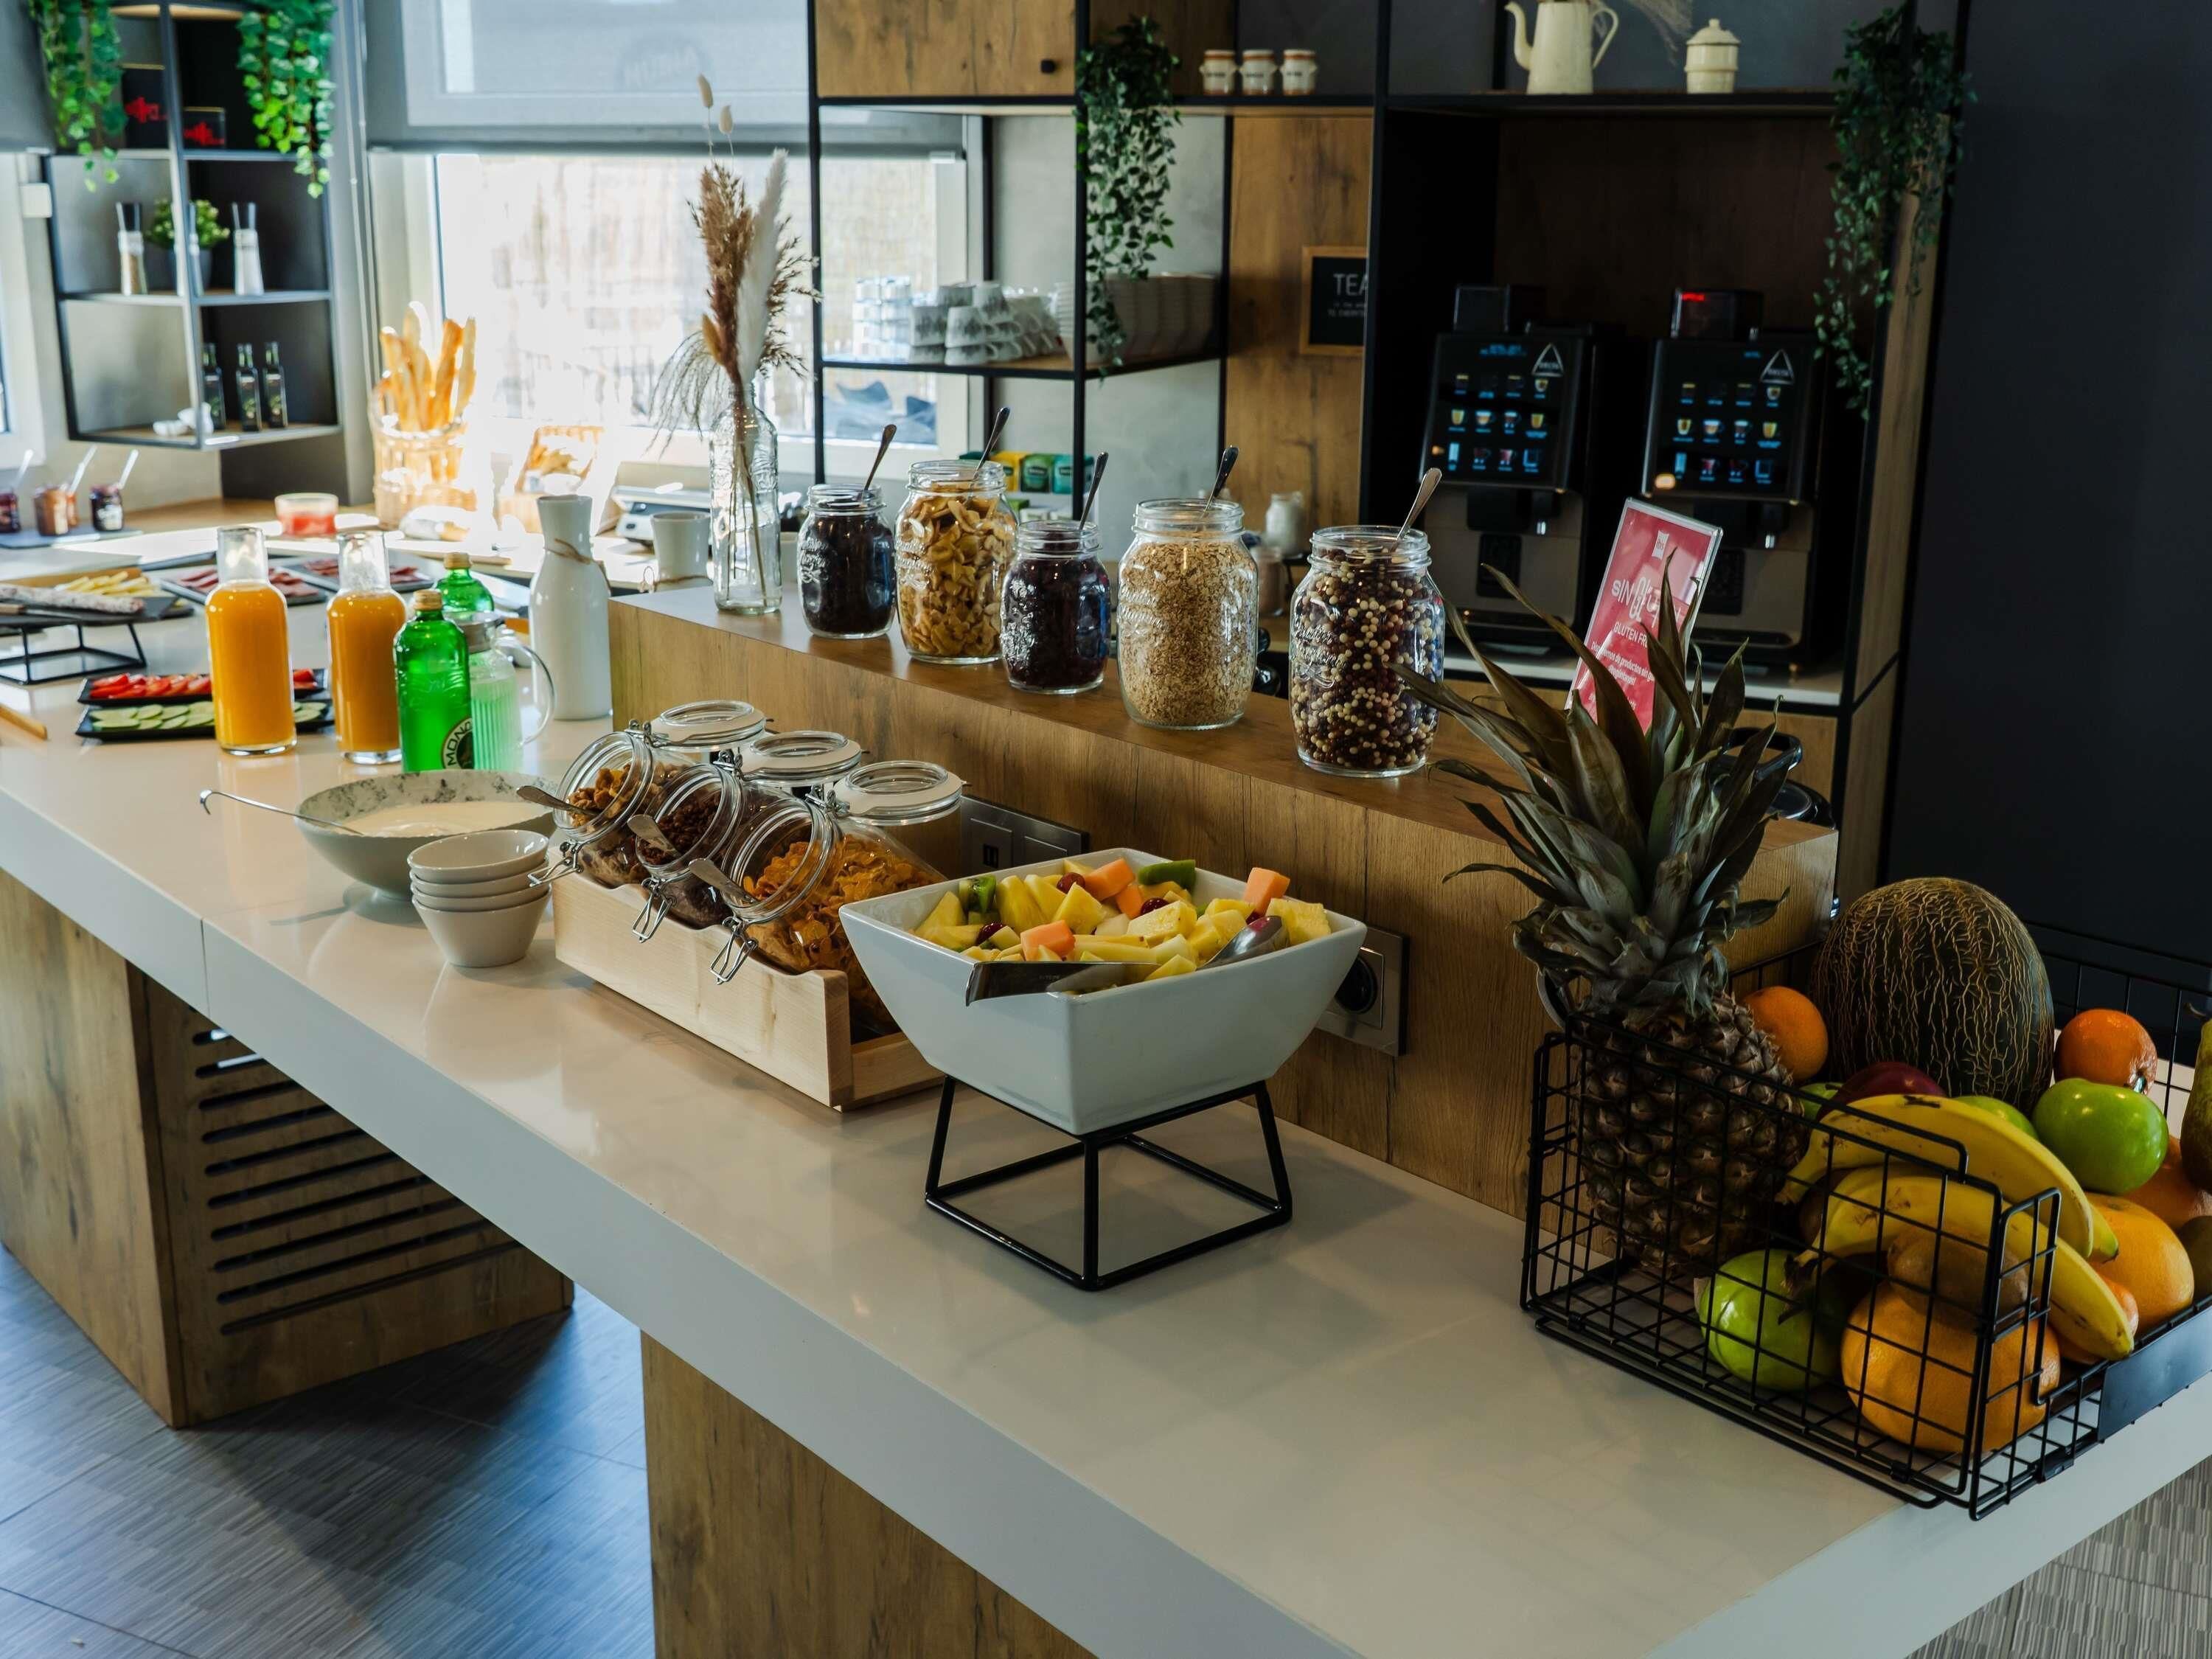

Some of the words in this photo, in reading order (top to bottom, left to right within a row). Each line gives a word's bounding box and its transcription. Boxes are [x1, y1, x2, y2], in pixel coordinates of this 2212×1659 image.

[1333, 273, 1368, 296] TEA
[1612, 580, 1635, 605] SIN
[1614, 622, 1638, 642] GLUTEN
